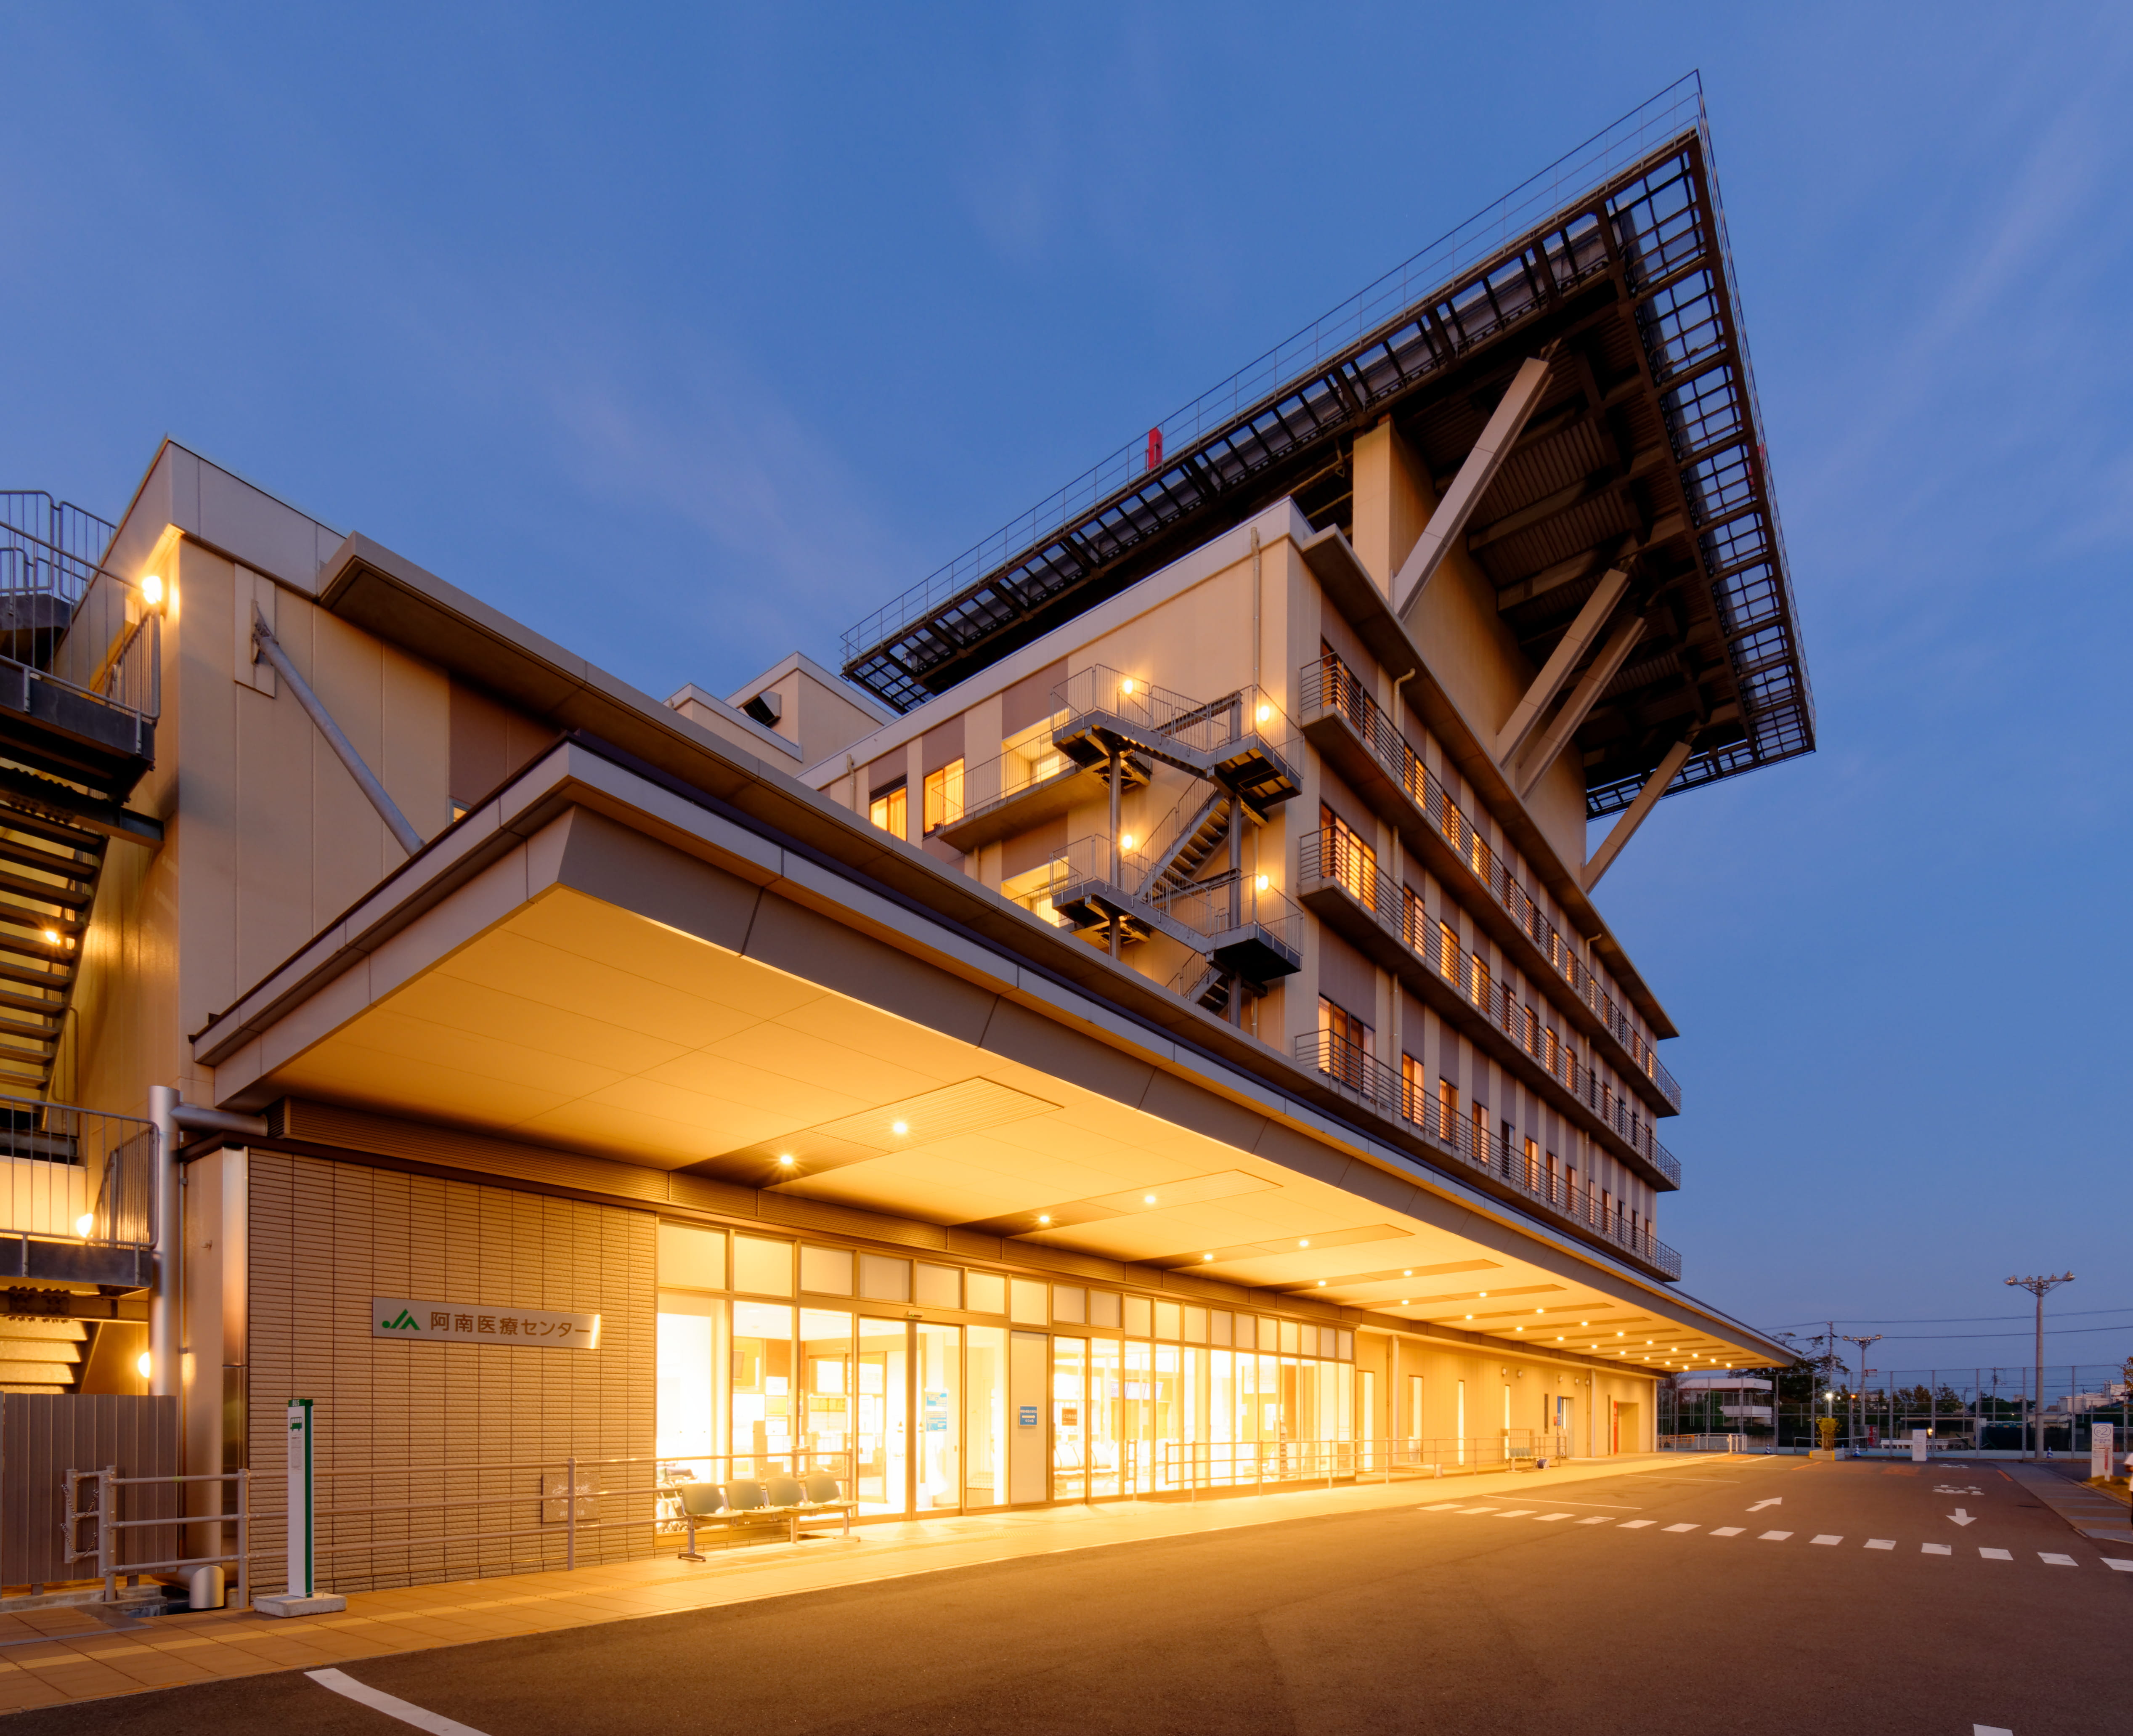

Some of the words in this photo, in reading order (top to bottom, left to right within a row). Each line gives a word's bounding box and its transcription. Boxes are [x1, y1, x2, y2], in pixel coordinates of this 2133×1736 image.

[430, 1311, 591, 1338] 阿南医療センター
